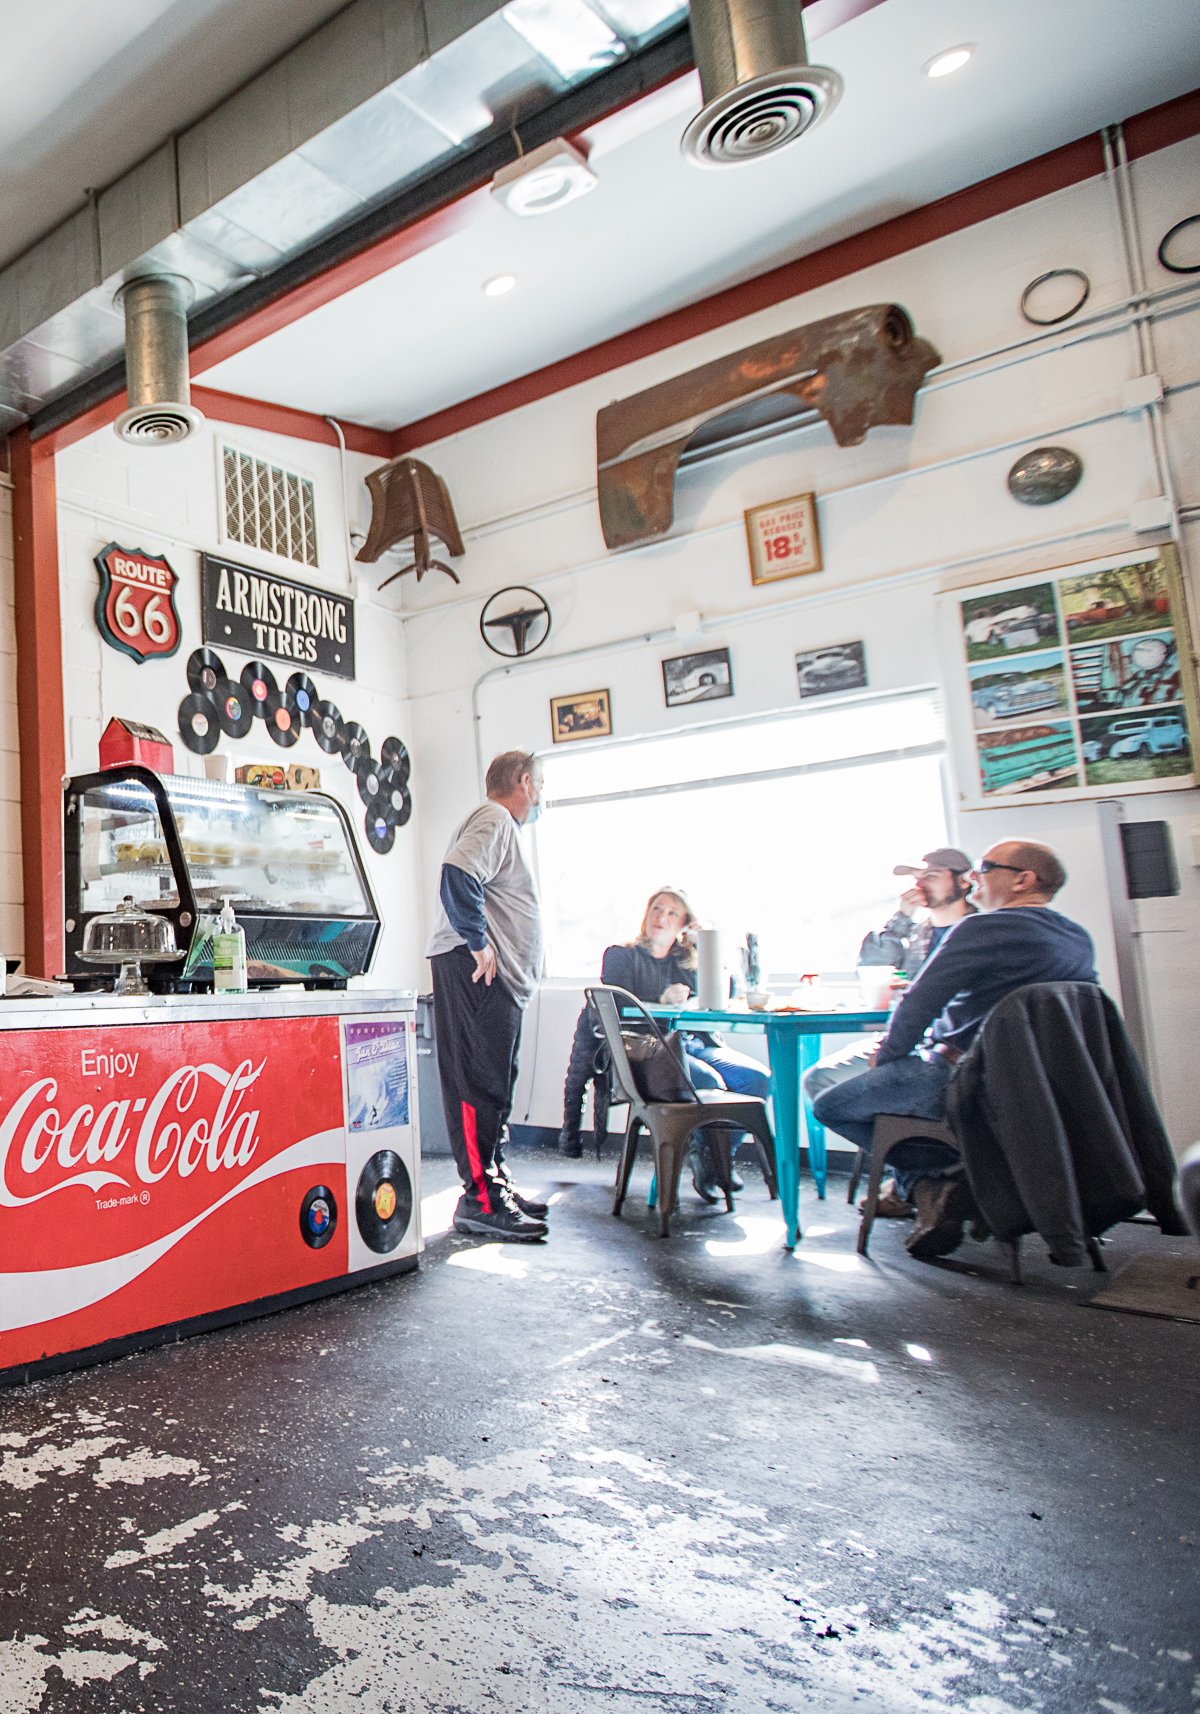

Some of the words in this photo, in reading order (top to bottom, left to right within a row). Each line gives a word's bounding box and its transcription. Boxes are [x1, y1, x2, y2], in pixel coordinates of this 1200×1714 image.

[764, 536, 792, 562] 18
[115, 586, 170, 645] 66
[215, 568, 347, 644] ARMSTRONG
[252, 622, 318, 663] TIRES
[81, 1048, 139, 1079] Enjoy
[95, 1194, 139, 1210] Trade-mark
